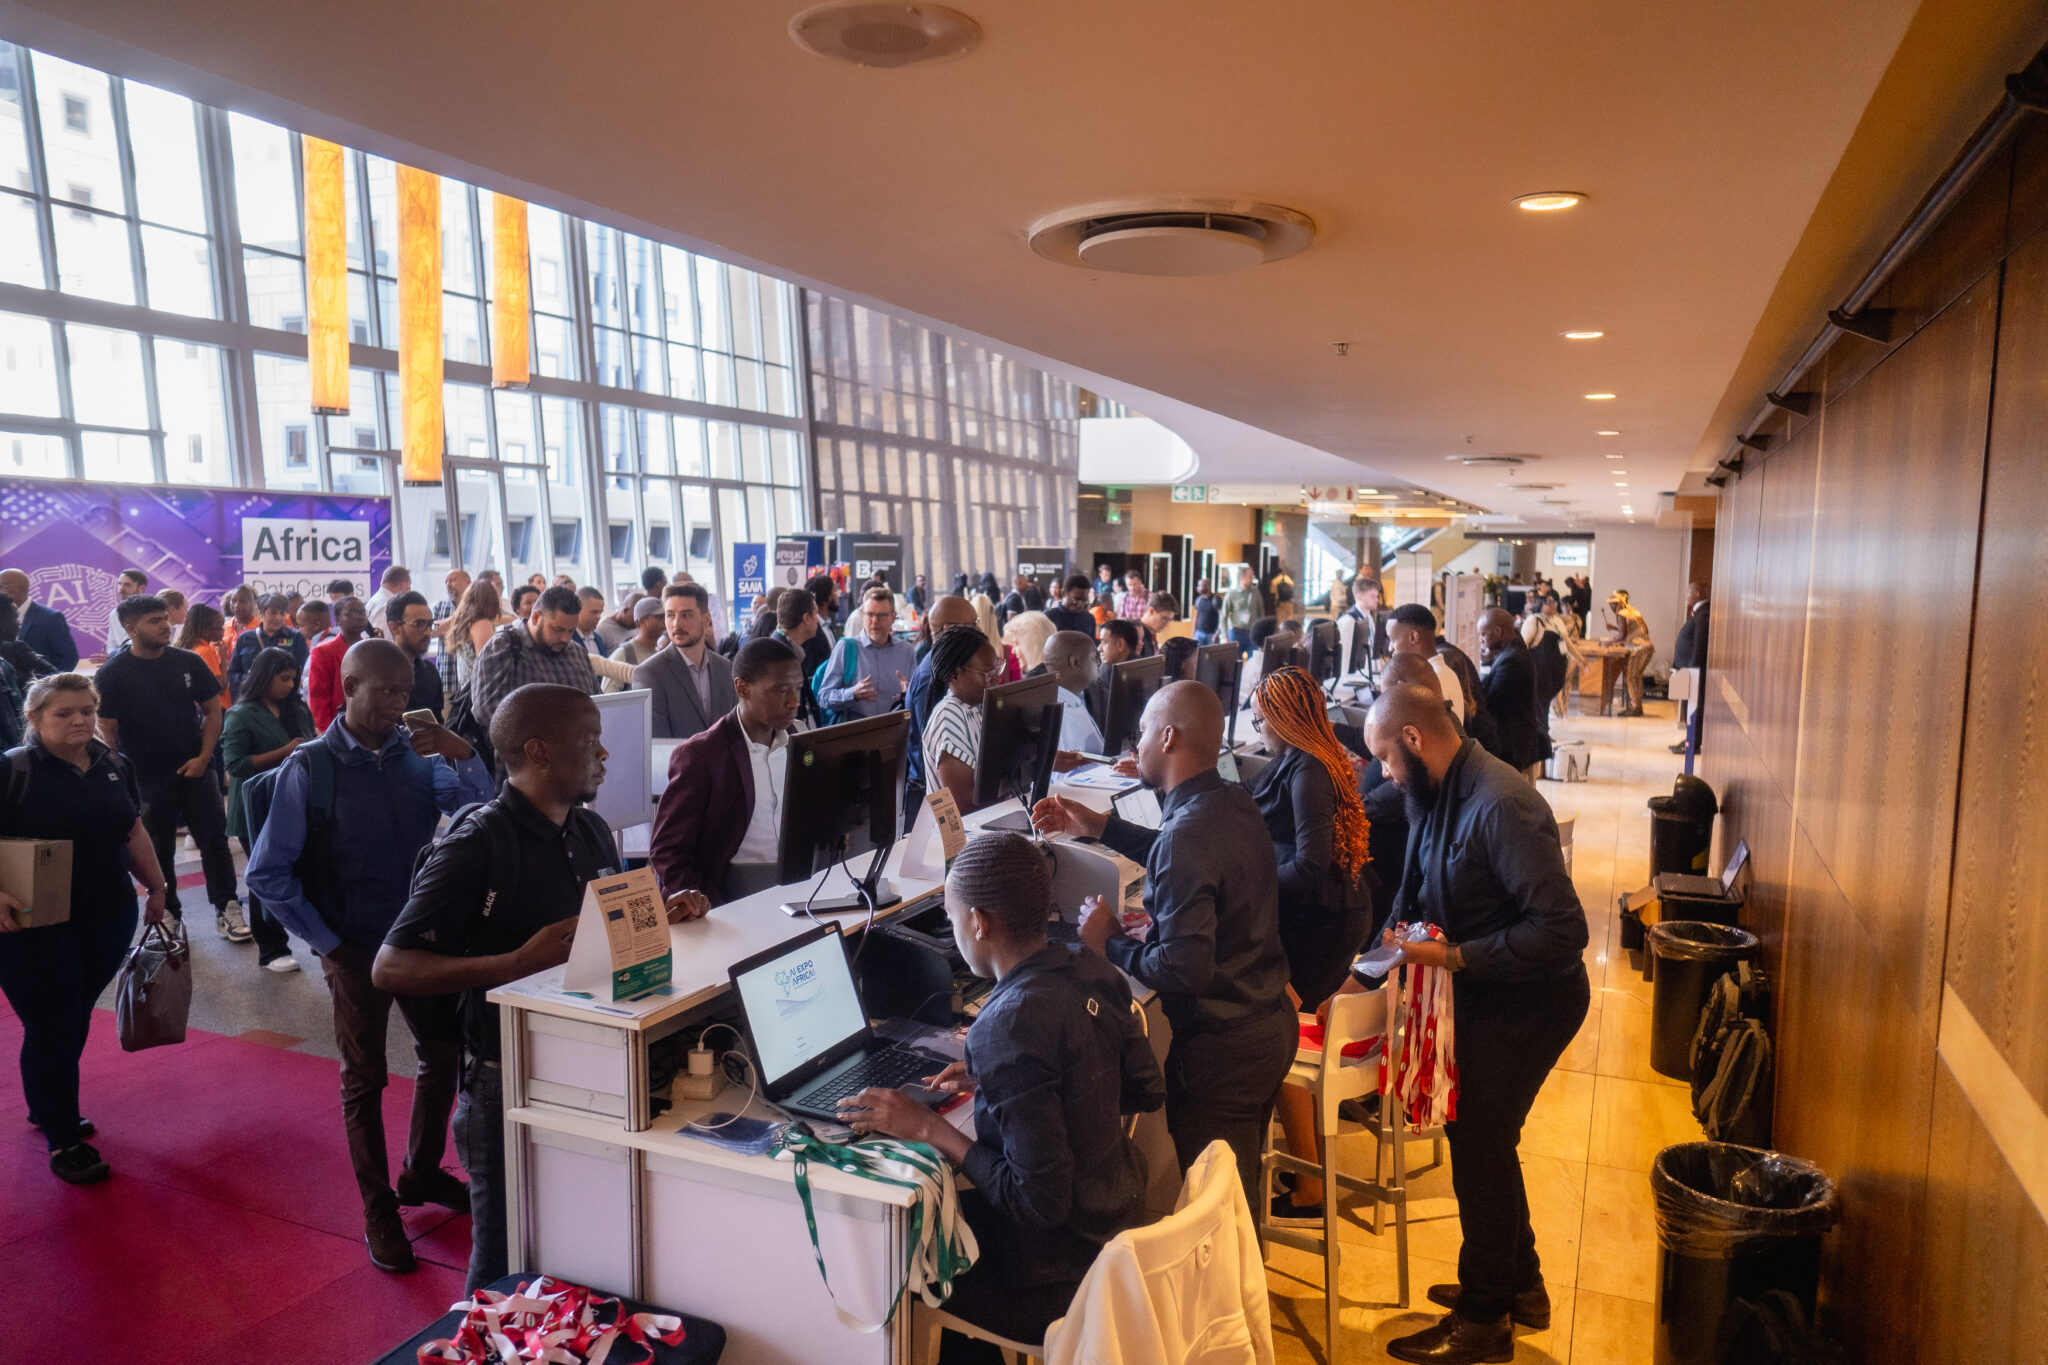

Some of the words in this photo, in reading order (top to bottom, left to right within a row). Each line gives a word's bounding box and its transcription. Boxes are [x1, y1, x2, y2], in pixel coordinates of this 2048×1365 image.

[252, 526, 362, 561] Africa
[46, 580, 89, 608] AI
[252, 579, 365, 599] DataCes
[482, 888, 497, 917] BLACK
[796, 959, 814, 973] EXPO
